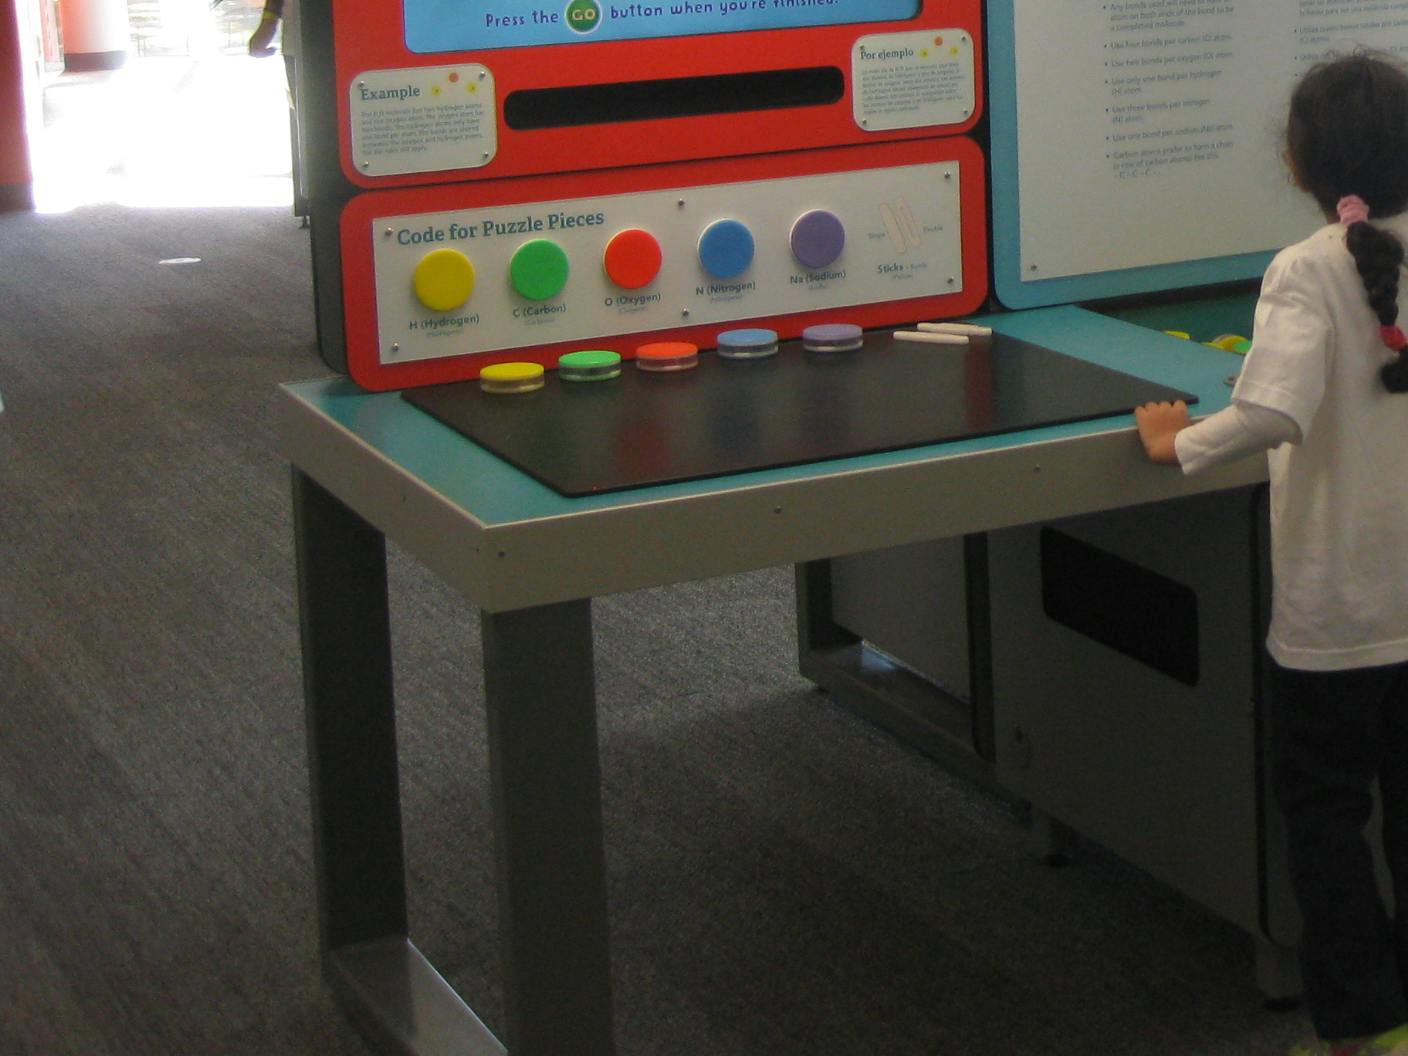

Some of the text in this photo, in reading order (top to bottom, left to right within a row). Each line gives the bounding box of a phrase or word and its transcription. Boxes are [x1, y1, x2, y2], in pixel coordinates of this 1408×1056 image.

[485, 12, 525, 28] Press
[531, 9, 559, 26] the
[570, 7, 596, 22] GO
[610, 3, 663, 20] button
[669, 1, 713, 17] when
[860, 47, 914, 61] Por ejemplo
[361, 84, 421, 101] Example
[397, 212, 605, 245] Code for Puzzle Pieces
[877, 262, 904, 275] Sticks
[804, 269, 847, 284] (Sodium)
[695, 280, 756, 296] N (Nitrogen)
[604, 292, 661, 307] O (Oxygen)
[512, 303, 567, 318] C (Carbon)
[408, 313, 480, 331] H (Hydrogen)
